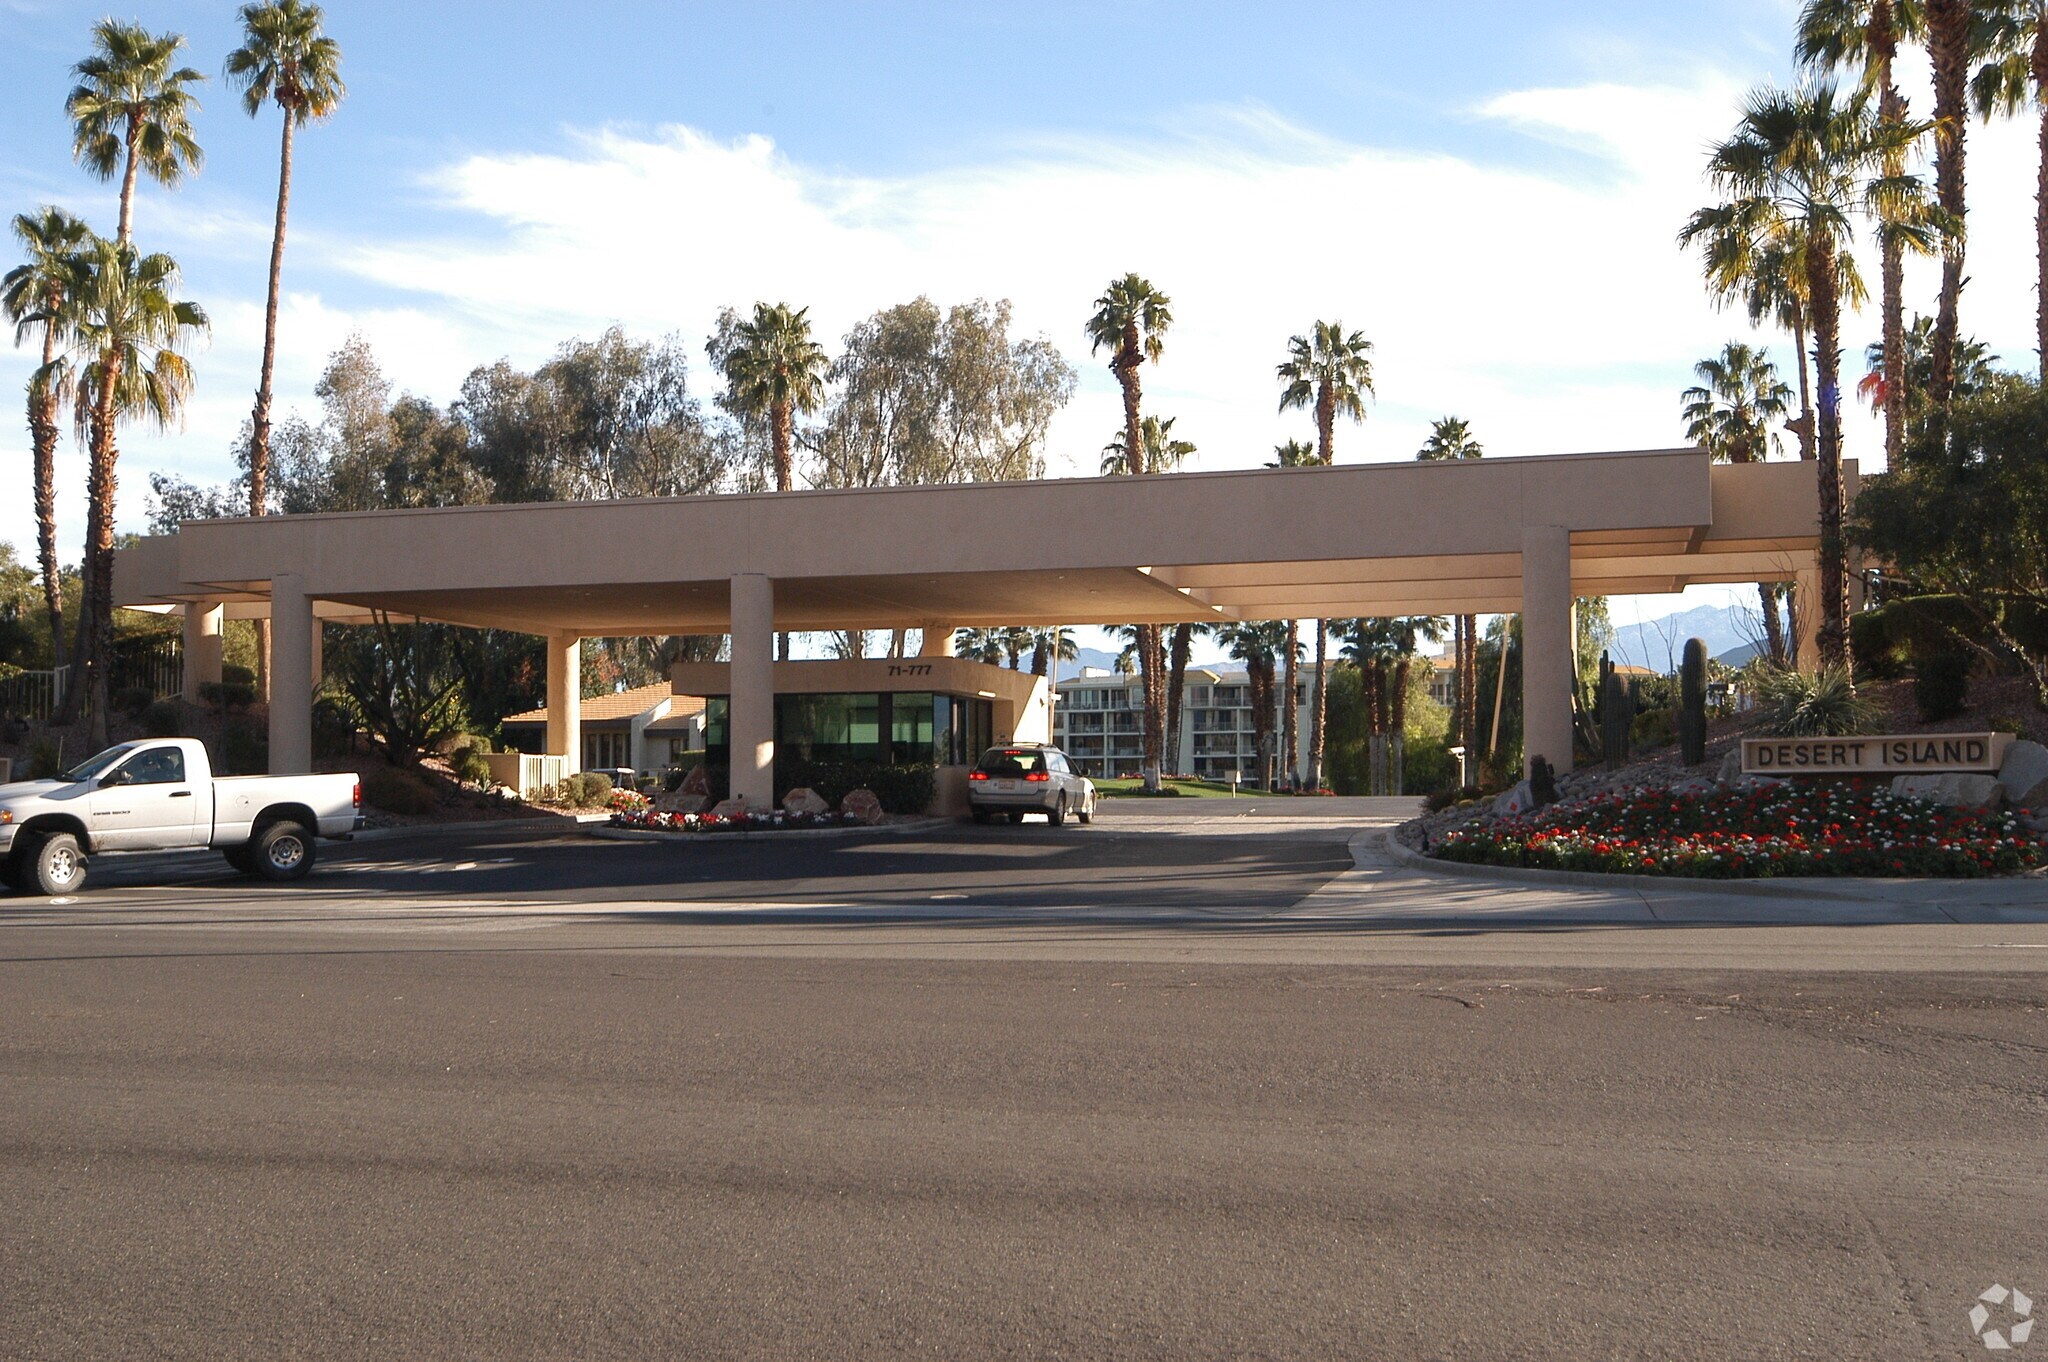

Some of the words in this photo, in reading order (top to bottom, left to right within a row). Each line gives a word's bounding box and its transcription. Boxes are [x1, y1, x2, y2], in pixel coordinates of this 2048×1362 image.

[888, 665, 932, 676] 71-777
[1758, 743, 1865, 766] DESERT
[1882, 740, 1984, 764] ISLAND
